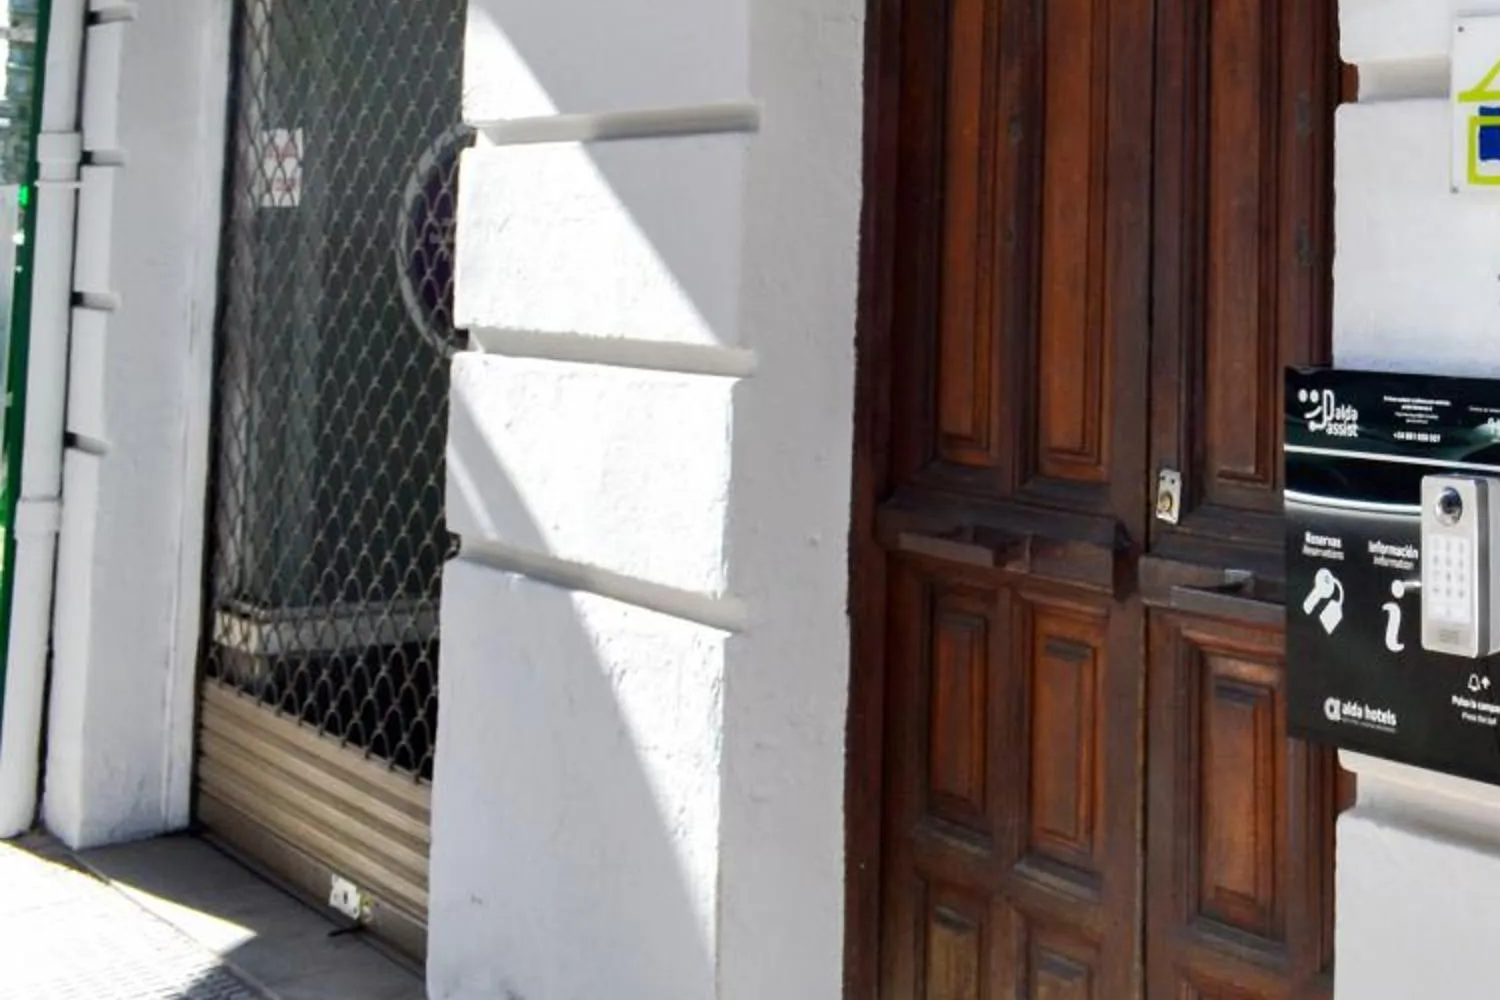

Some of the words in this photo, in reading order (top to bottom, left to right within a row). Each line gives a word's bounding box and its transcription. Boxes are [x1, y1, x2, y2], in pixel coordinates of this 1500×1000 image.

[1334, 404, 1359, 421] alda
[1342, 700, 1362, 719] alda
[1364, 704, 1397, 727] hotels
